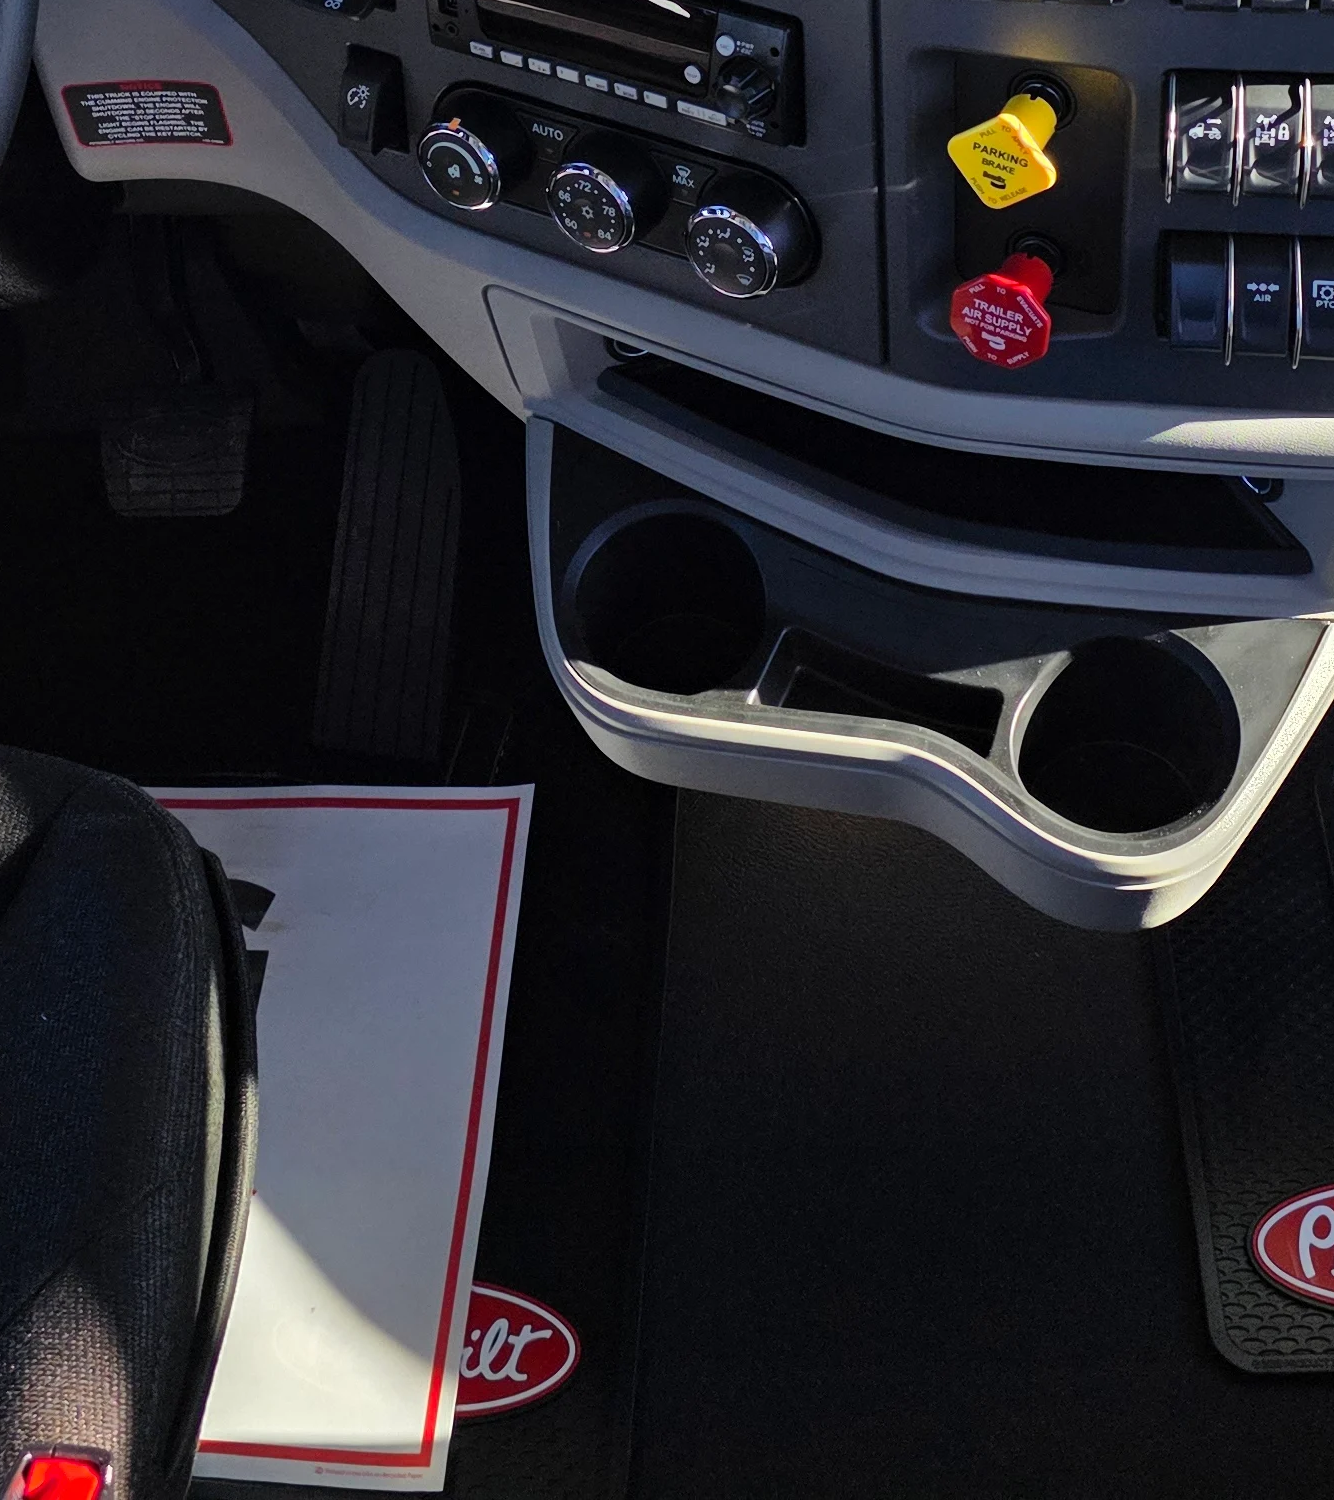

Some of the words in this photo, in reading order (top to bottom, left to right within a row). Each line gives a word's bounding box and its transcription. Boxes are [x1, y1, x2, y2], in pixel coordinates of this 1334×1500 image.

[532, 123, 563, 142] AUTO
[1001, 125, 1012, 133] TO
[972, 141, 1028, 168] PARKING
[981, 157, 1016, 175] BRAKE
[578, 180, 592, 193] 72
[672, 174, 695, 189] MAX
[558, 190, 571, 203] 66
[999, 187, 1028, 202] RELEASE
[602, 205, 616, 217] 78
[564, 218, 578, 230] 60
[597, 229, 612, 240] 84
[1253, 293, 1271, 302] AIR
[968, 283, 985, 294] PULL
[996, 286, 1006, 295] TO
[1016, 295, 1044, 329] EVACUATE
[973, 298, 1024, 324] TRAILER
[961, 306, 982, 320] AIR
[984, 313, 1033, 337] SUPPLY
[964, 317, 979, 327] NOT
[979, 321, 995, 332] FOR
[986, 353, 998, 361] TO
